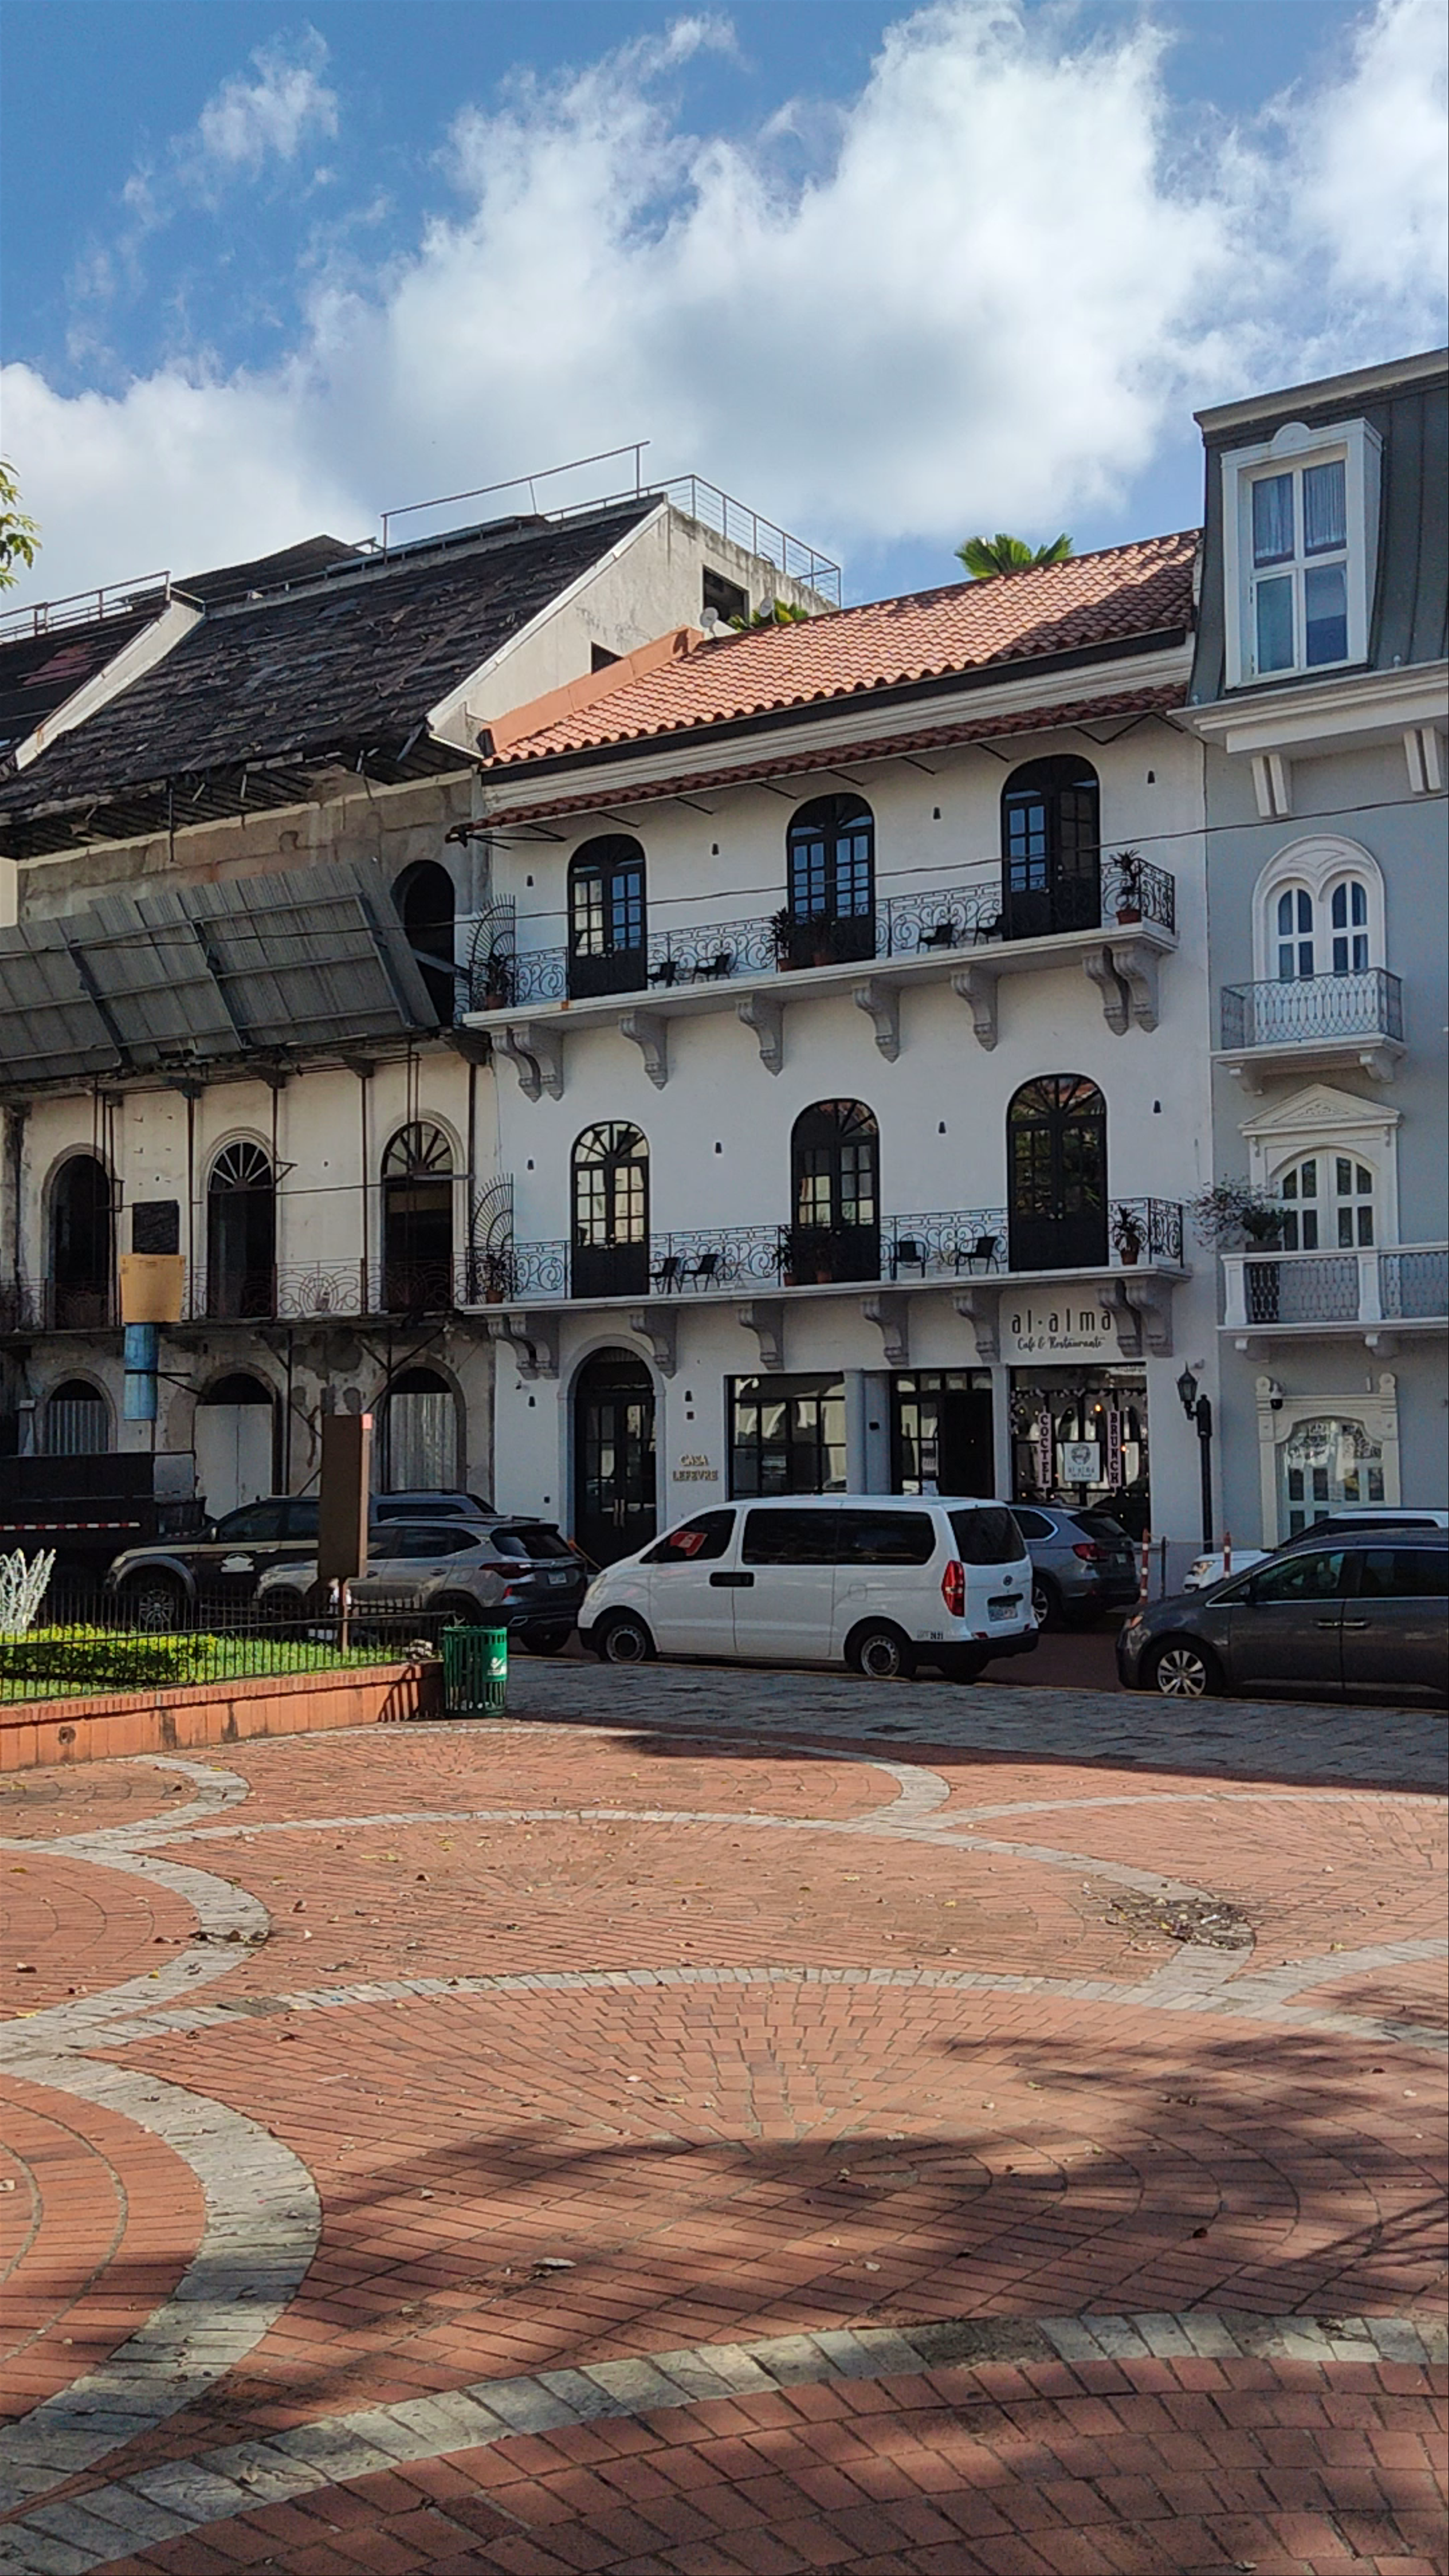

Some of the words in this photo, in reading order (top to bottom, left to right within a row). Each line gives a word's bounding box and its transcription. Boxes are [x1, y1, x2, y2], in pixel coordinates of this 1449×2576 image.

[681, 1454, 708, 1466] CASA
[1040, 1415, 1049, 1484] COCTEL
[1110, 1412, 1120, 1484] BRUNCH
[673, 1470, 718, 1481] LEFEVRE
